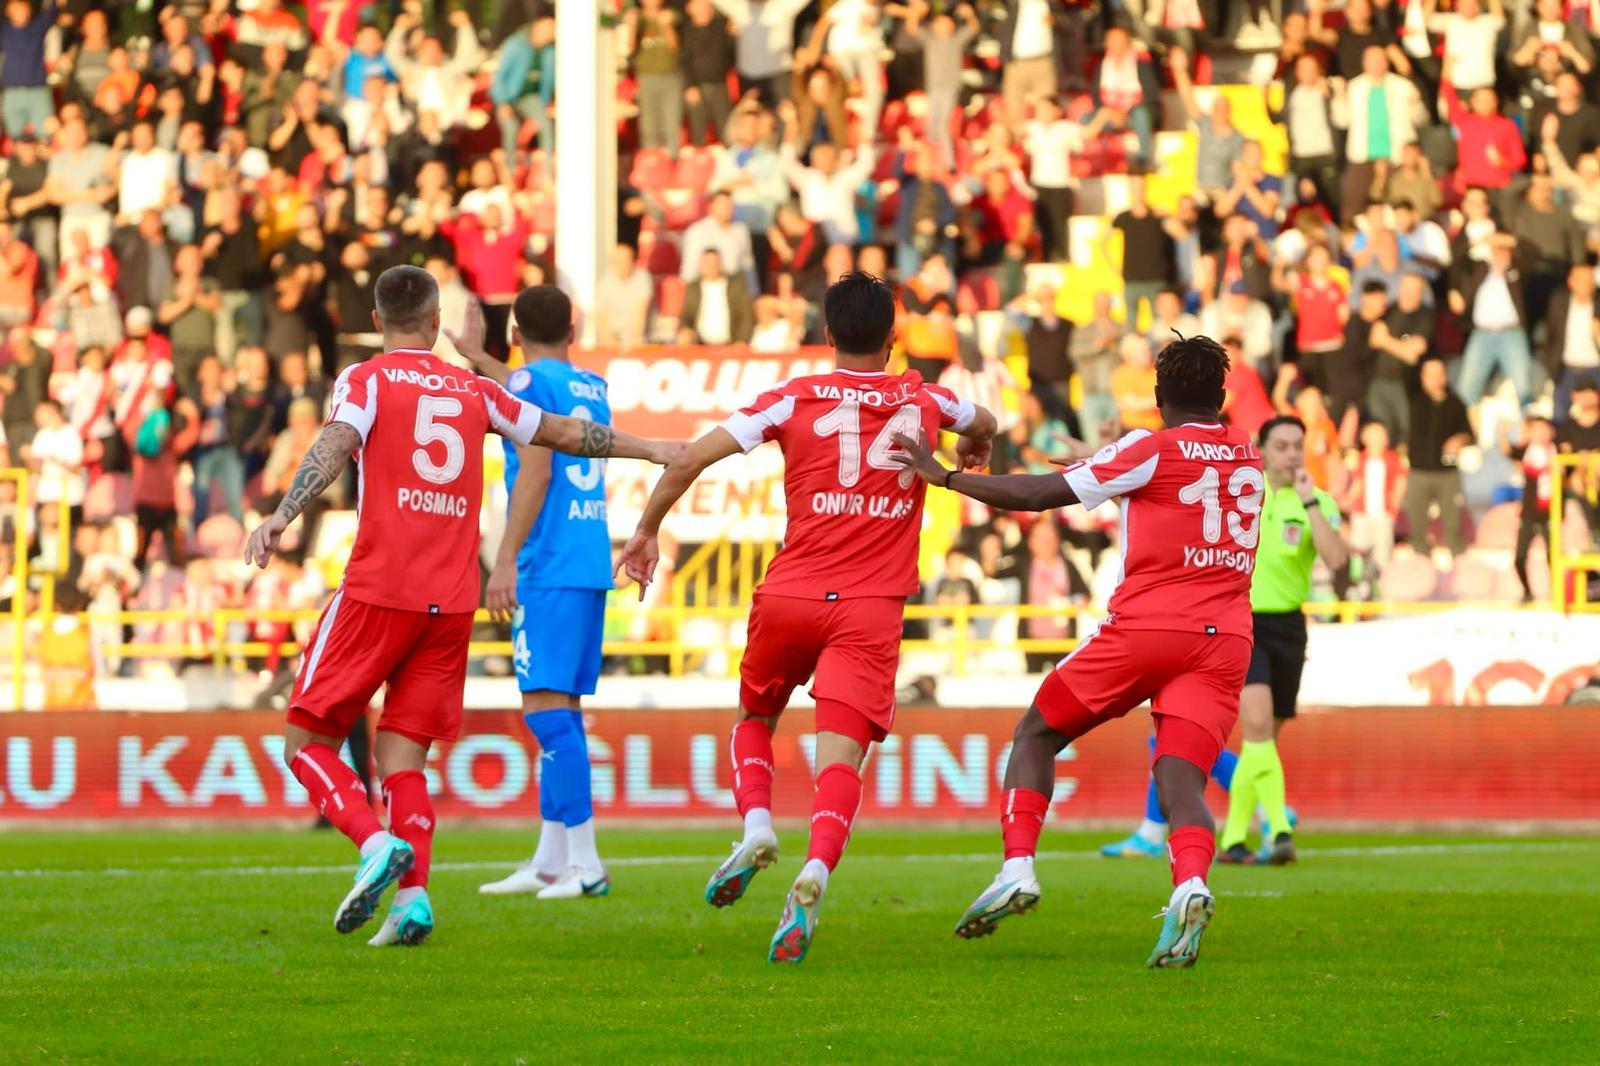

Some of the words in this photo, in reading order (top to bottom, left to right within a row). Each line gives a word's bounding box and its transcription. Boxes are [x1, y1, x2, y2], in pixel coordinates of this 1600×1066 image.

[412, 394, 465, 485] 5
[813, 400, 922, 490] 14
[397, 487, 467, 517] POSMAC
[812, 492, 865, 516] ONUR
[1179, 466, 1264, 549] 13
[0, 735, 77, 809] U
